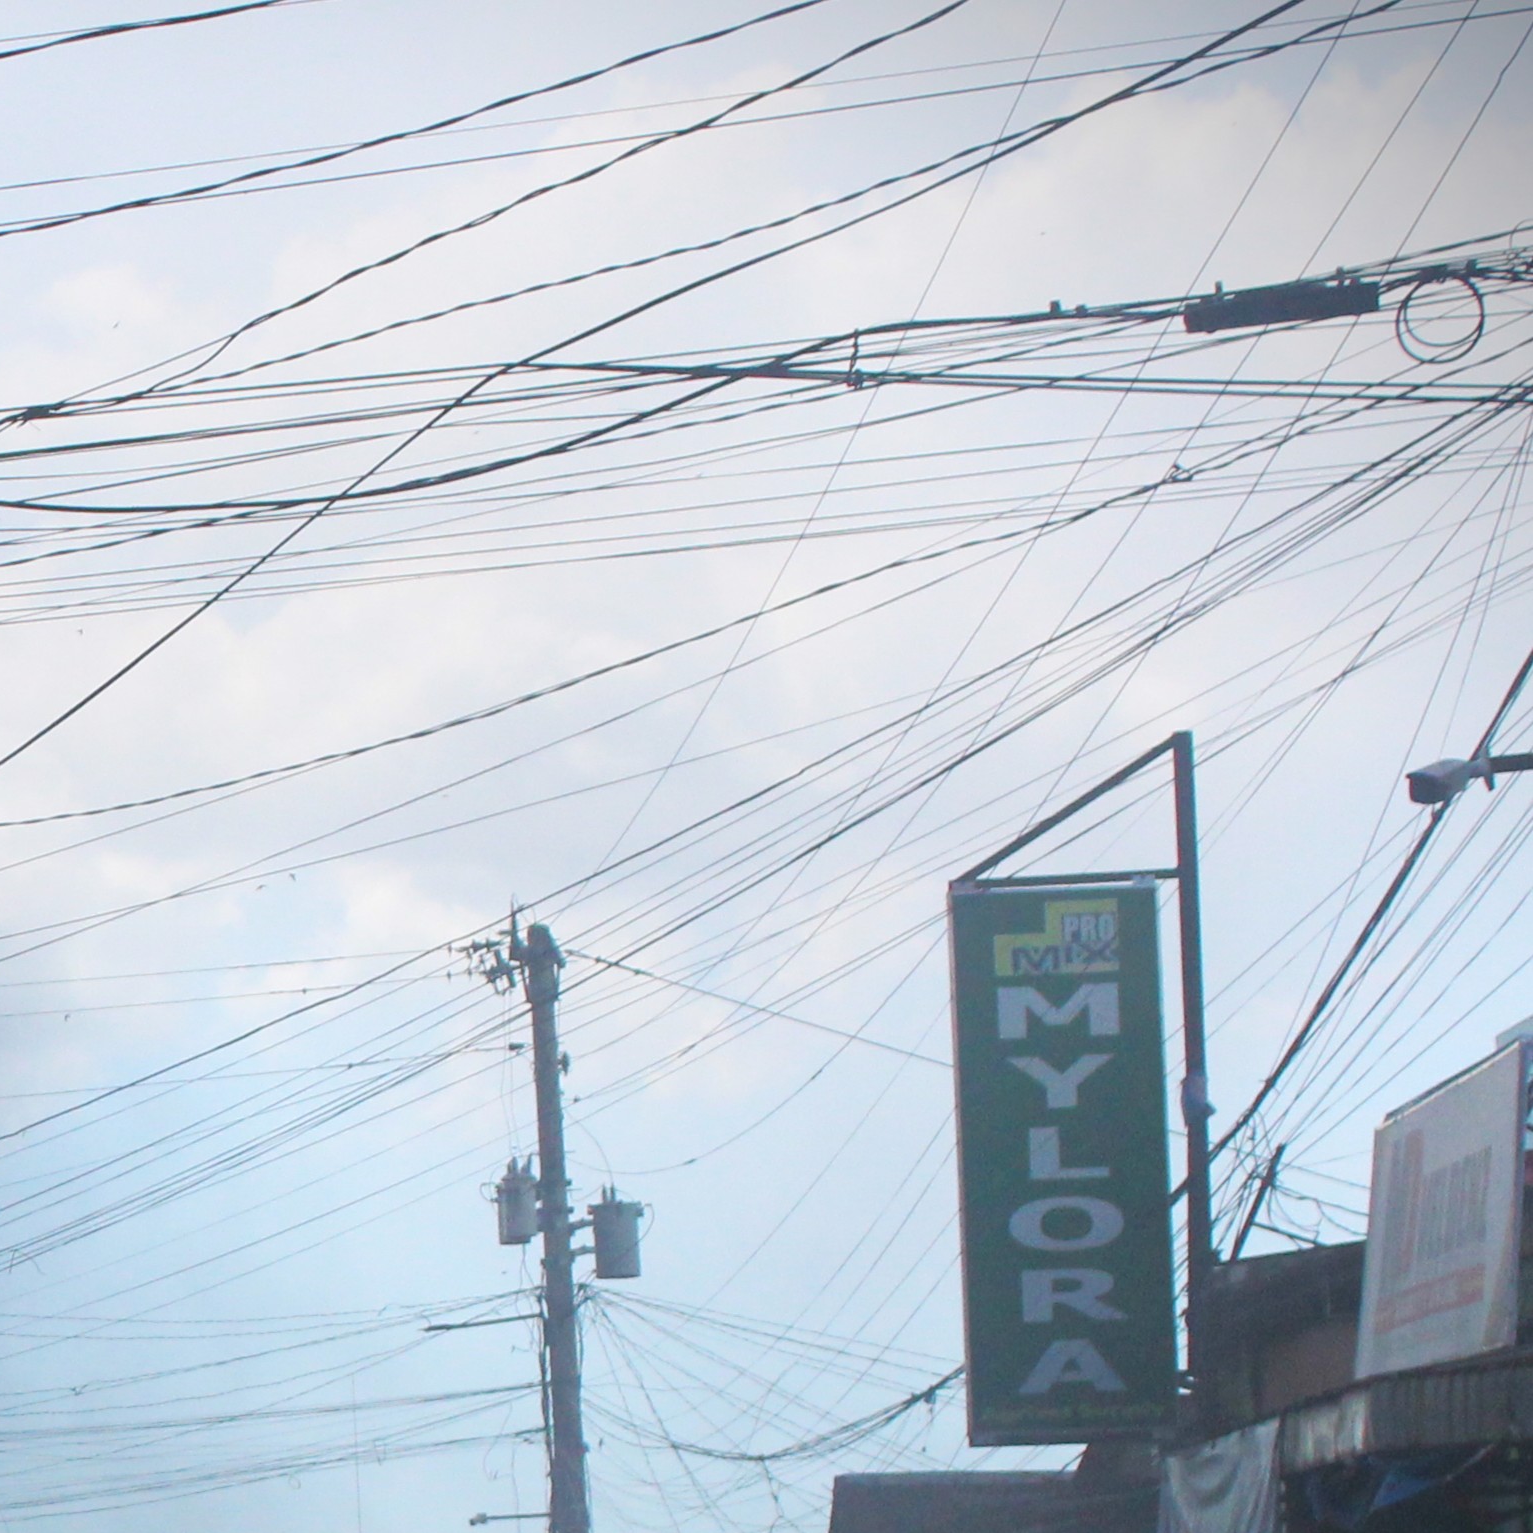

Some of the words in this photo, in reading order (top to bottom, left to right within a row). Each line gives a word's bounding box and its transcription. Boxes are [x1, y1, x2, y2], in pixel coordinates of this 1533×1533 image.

[1062, 913, 1115, 942] PRO
[1011, 941, 1119, 976] MIX
[996, 981, 1128, 1394] MYLORA
